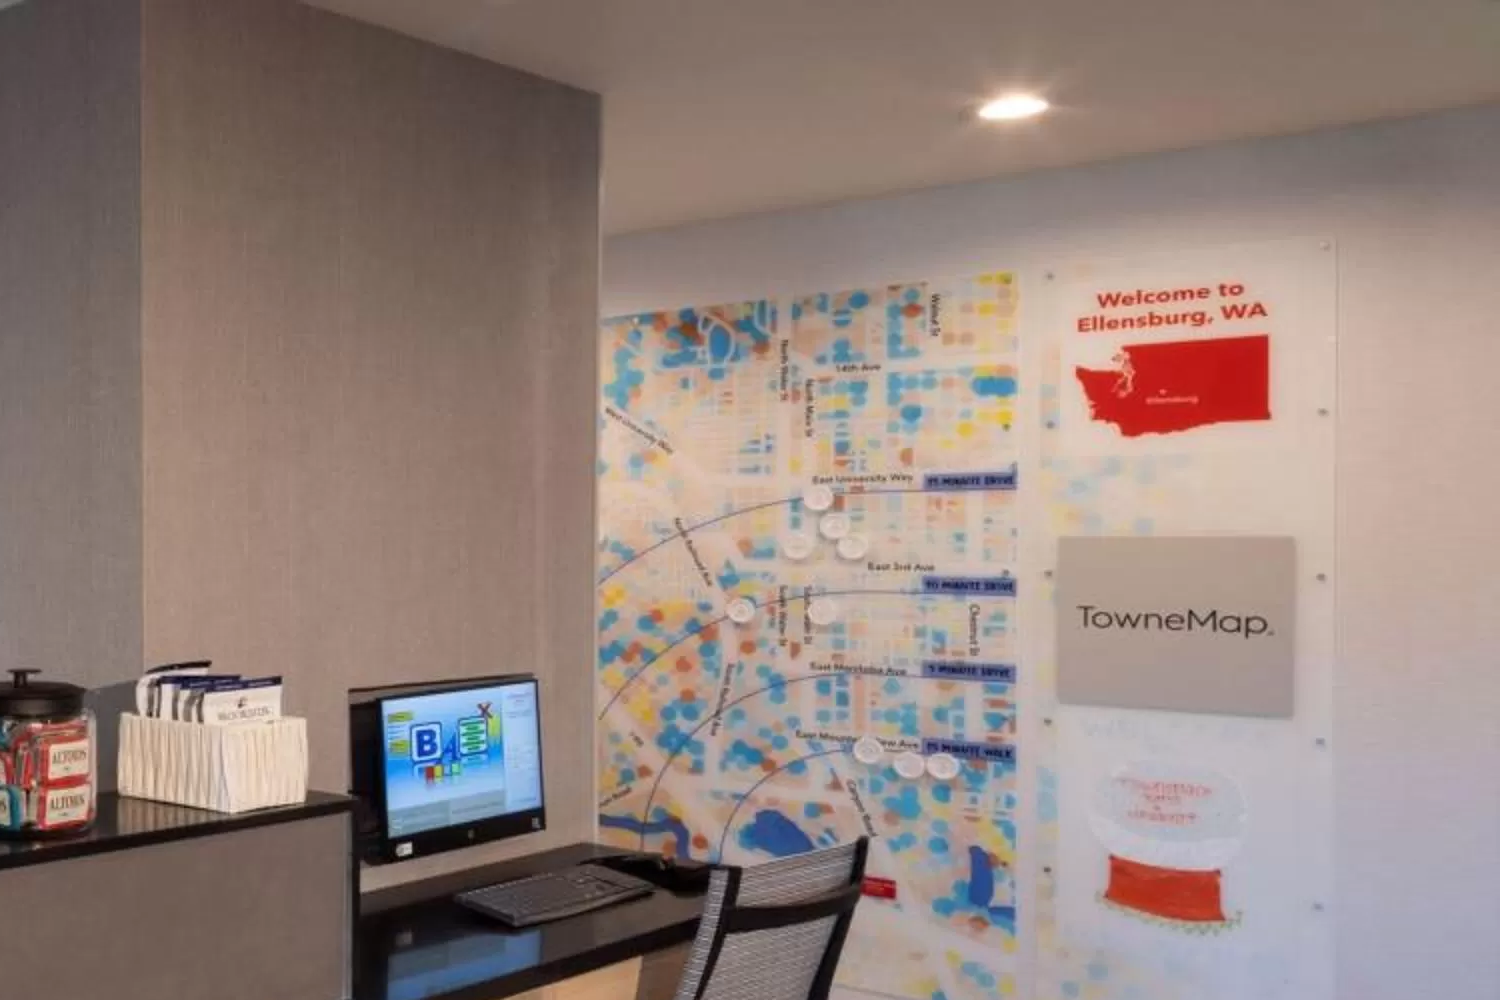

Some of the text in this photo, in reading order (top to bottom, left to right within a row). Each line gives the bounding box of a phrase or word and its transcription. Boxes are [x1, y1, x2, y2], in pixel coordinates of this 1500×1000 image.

[1097, 283, 1245, 309] Welcome to
[1077, 302, 1268, 333] Ellensburg, WA
[812, 473, 913, 484] East University Way
[867, 562, 890, 571] East
[914, 563, 934, 572] Ave
[416, 729, 438, 758] B
